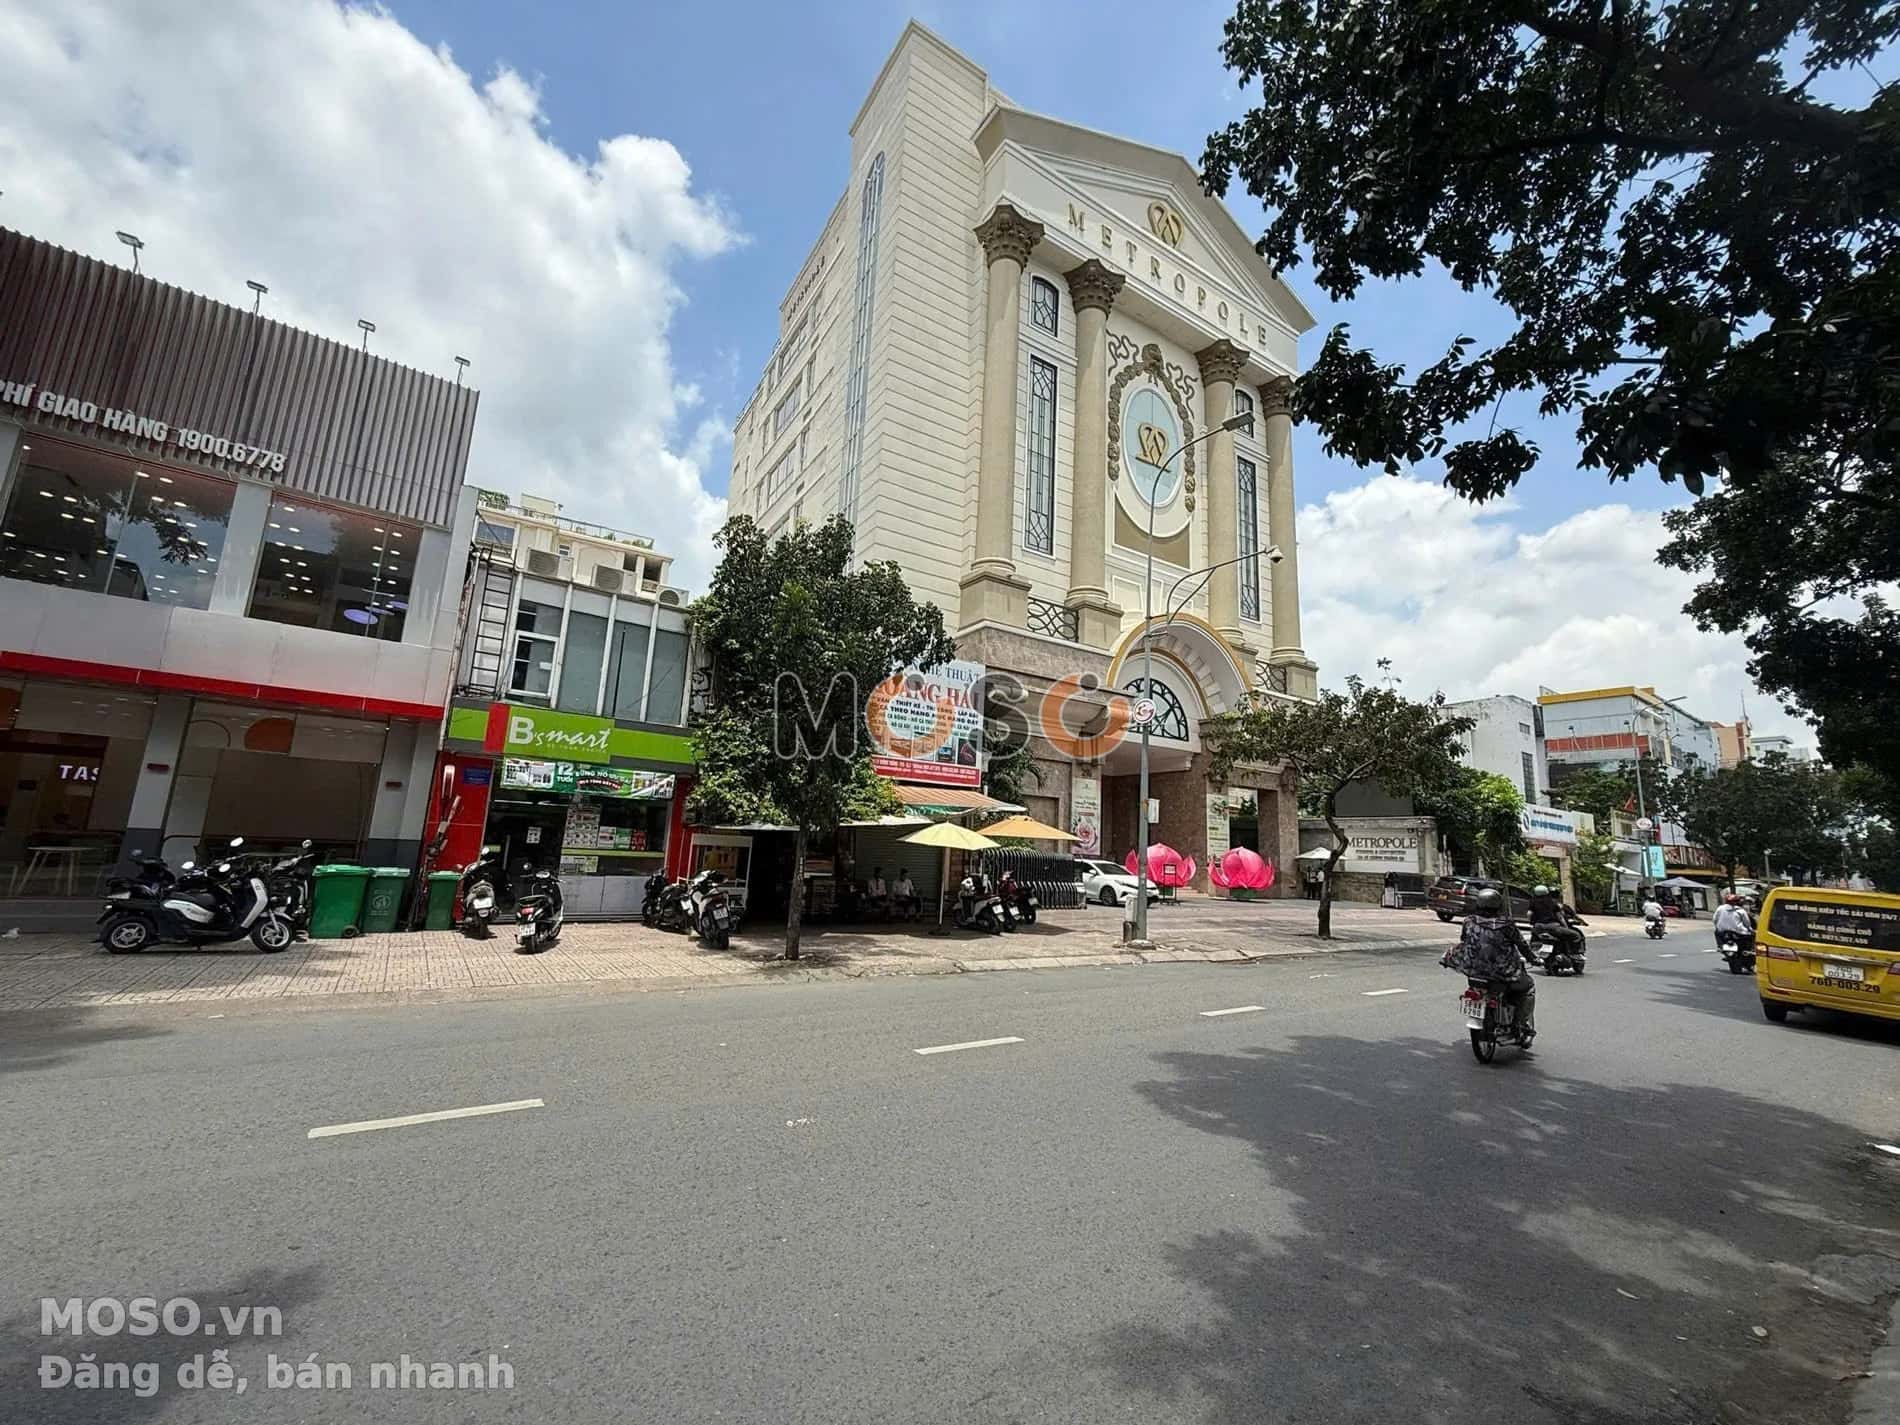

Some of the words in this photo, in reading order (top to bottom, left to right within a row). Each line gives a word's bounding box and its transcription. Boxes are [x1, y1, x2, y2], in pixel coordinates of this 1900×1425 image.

[1068, 202, 1267, 346] METROPOLE
[37, 390, 98, 423] GIAO
[102, 408, 168, 442] HÀNG
[177, 428, 287, 473] 1900.6778
[557, 761, 574, 776] 12
[1348, 837, 1417, 849] METROPOLE
